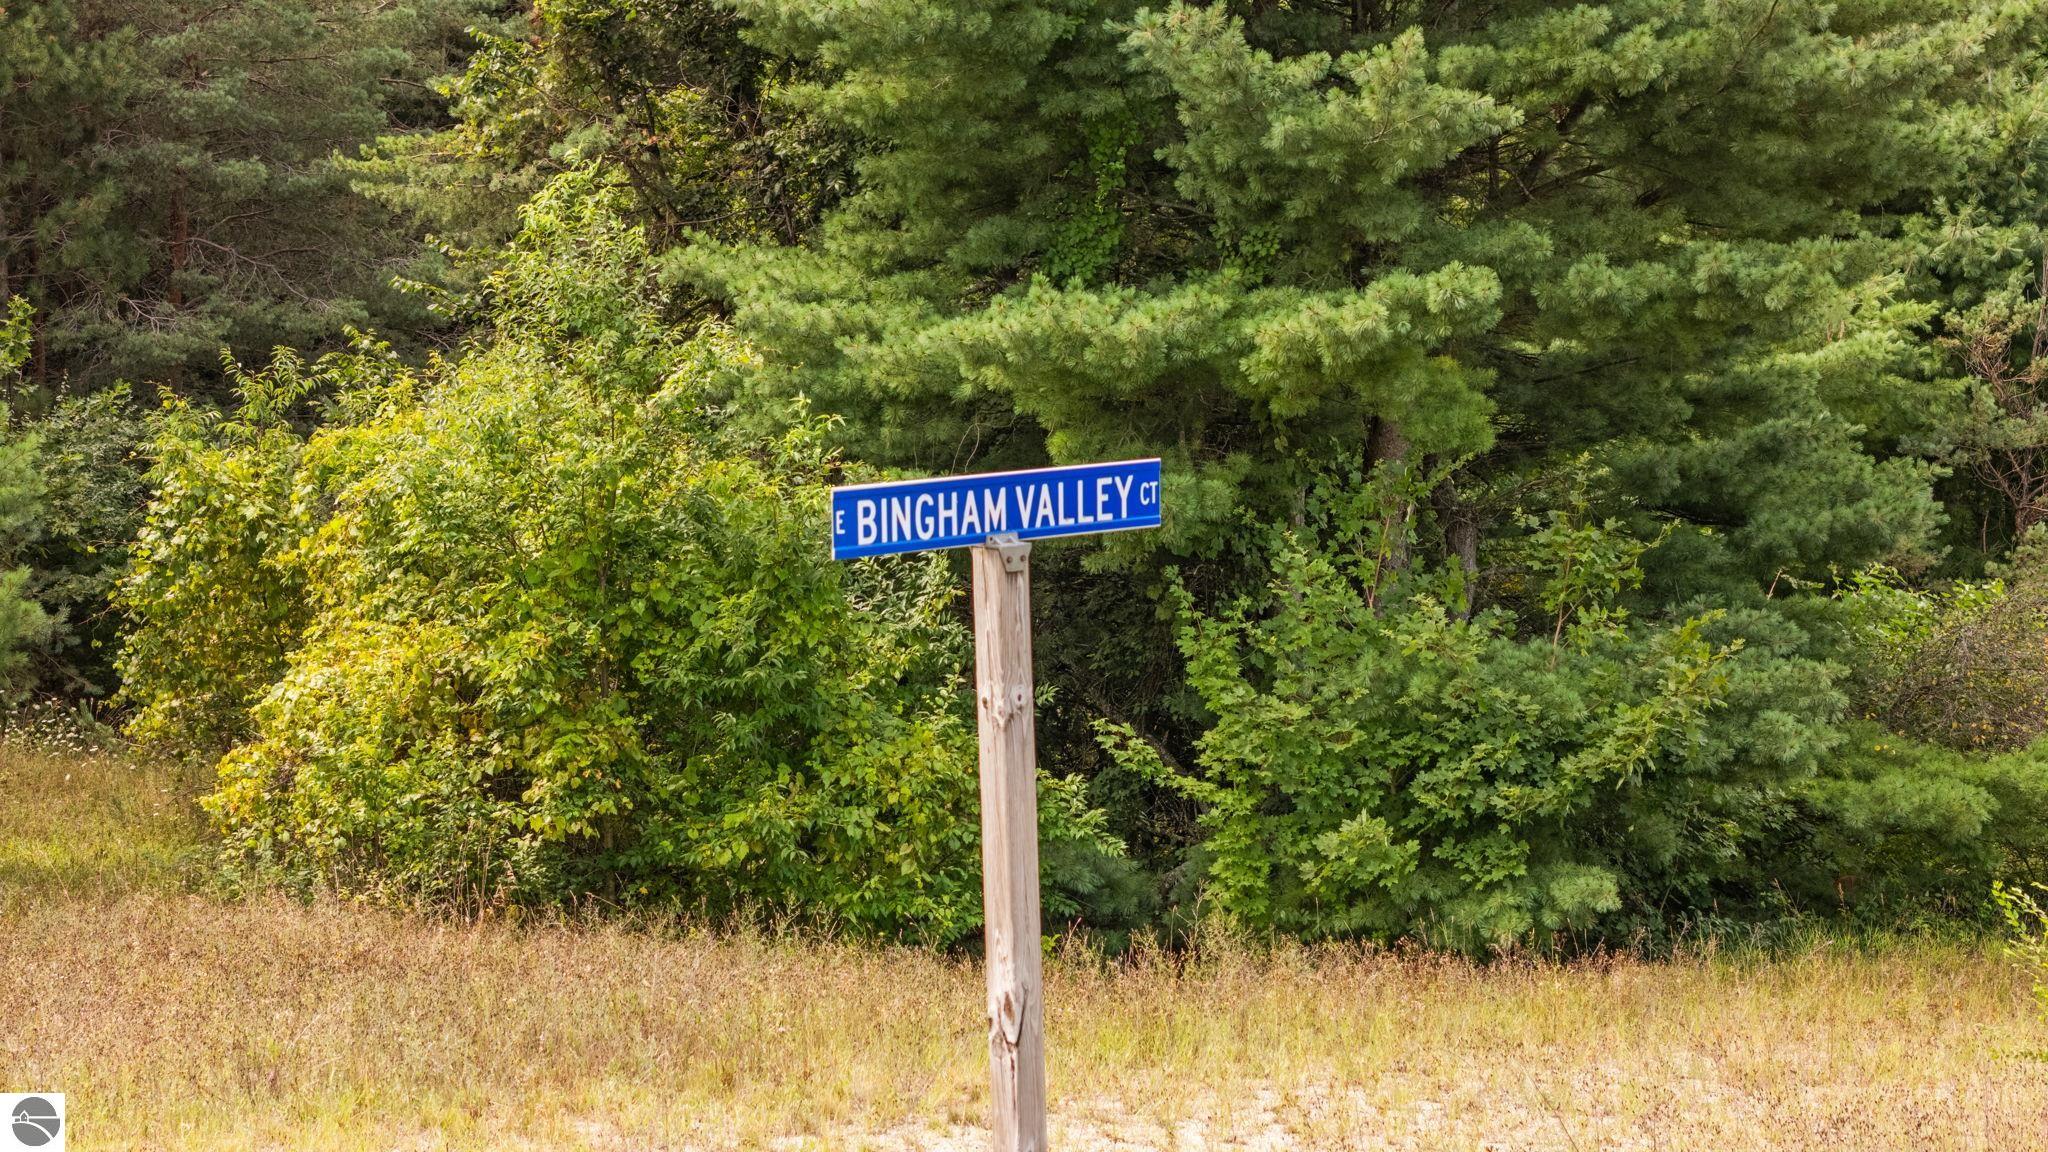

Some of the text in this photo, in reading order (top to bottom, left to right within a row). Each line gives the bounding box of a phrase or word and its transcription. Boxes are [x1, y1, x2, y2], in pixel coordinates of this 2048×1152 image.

[835, 474, 1158, 546] E BINGHAM VALLEY CT
